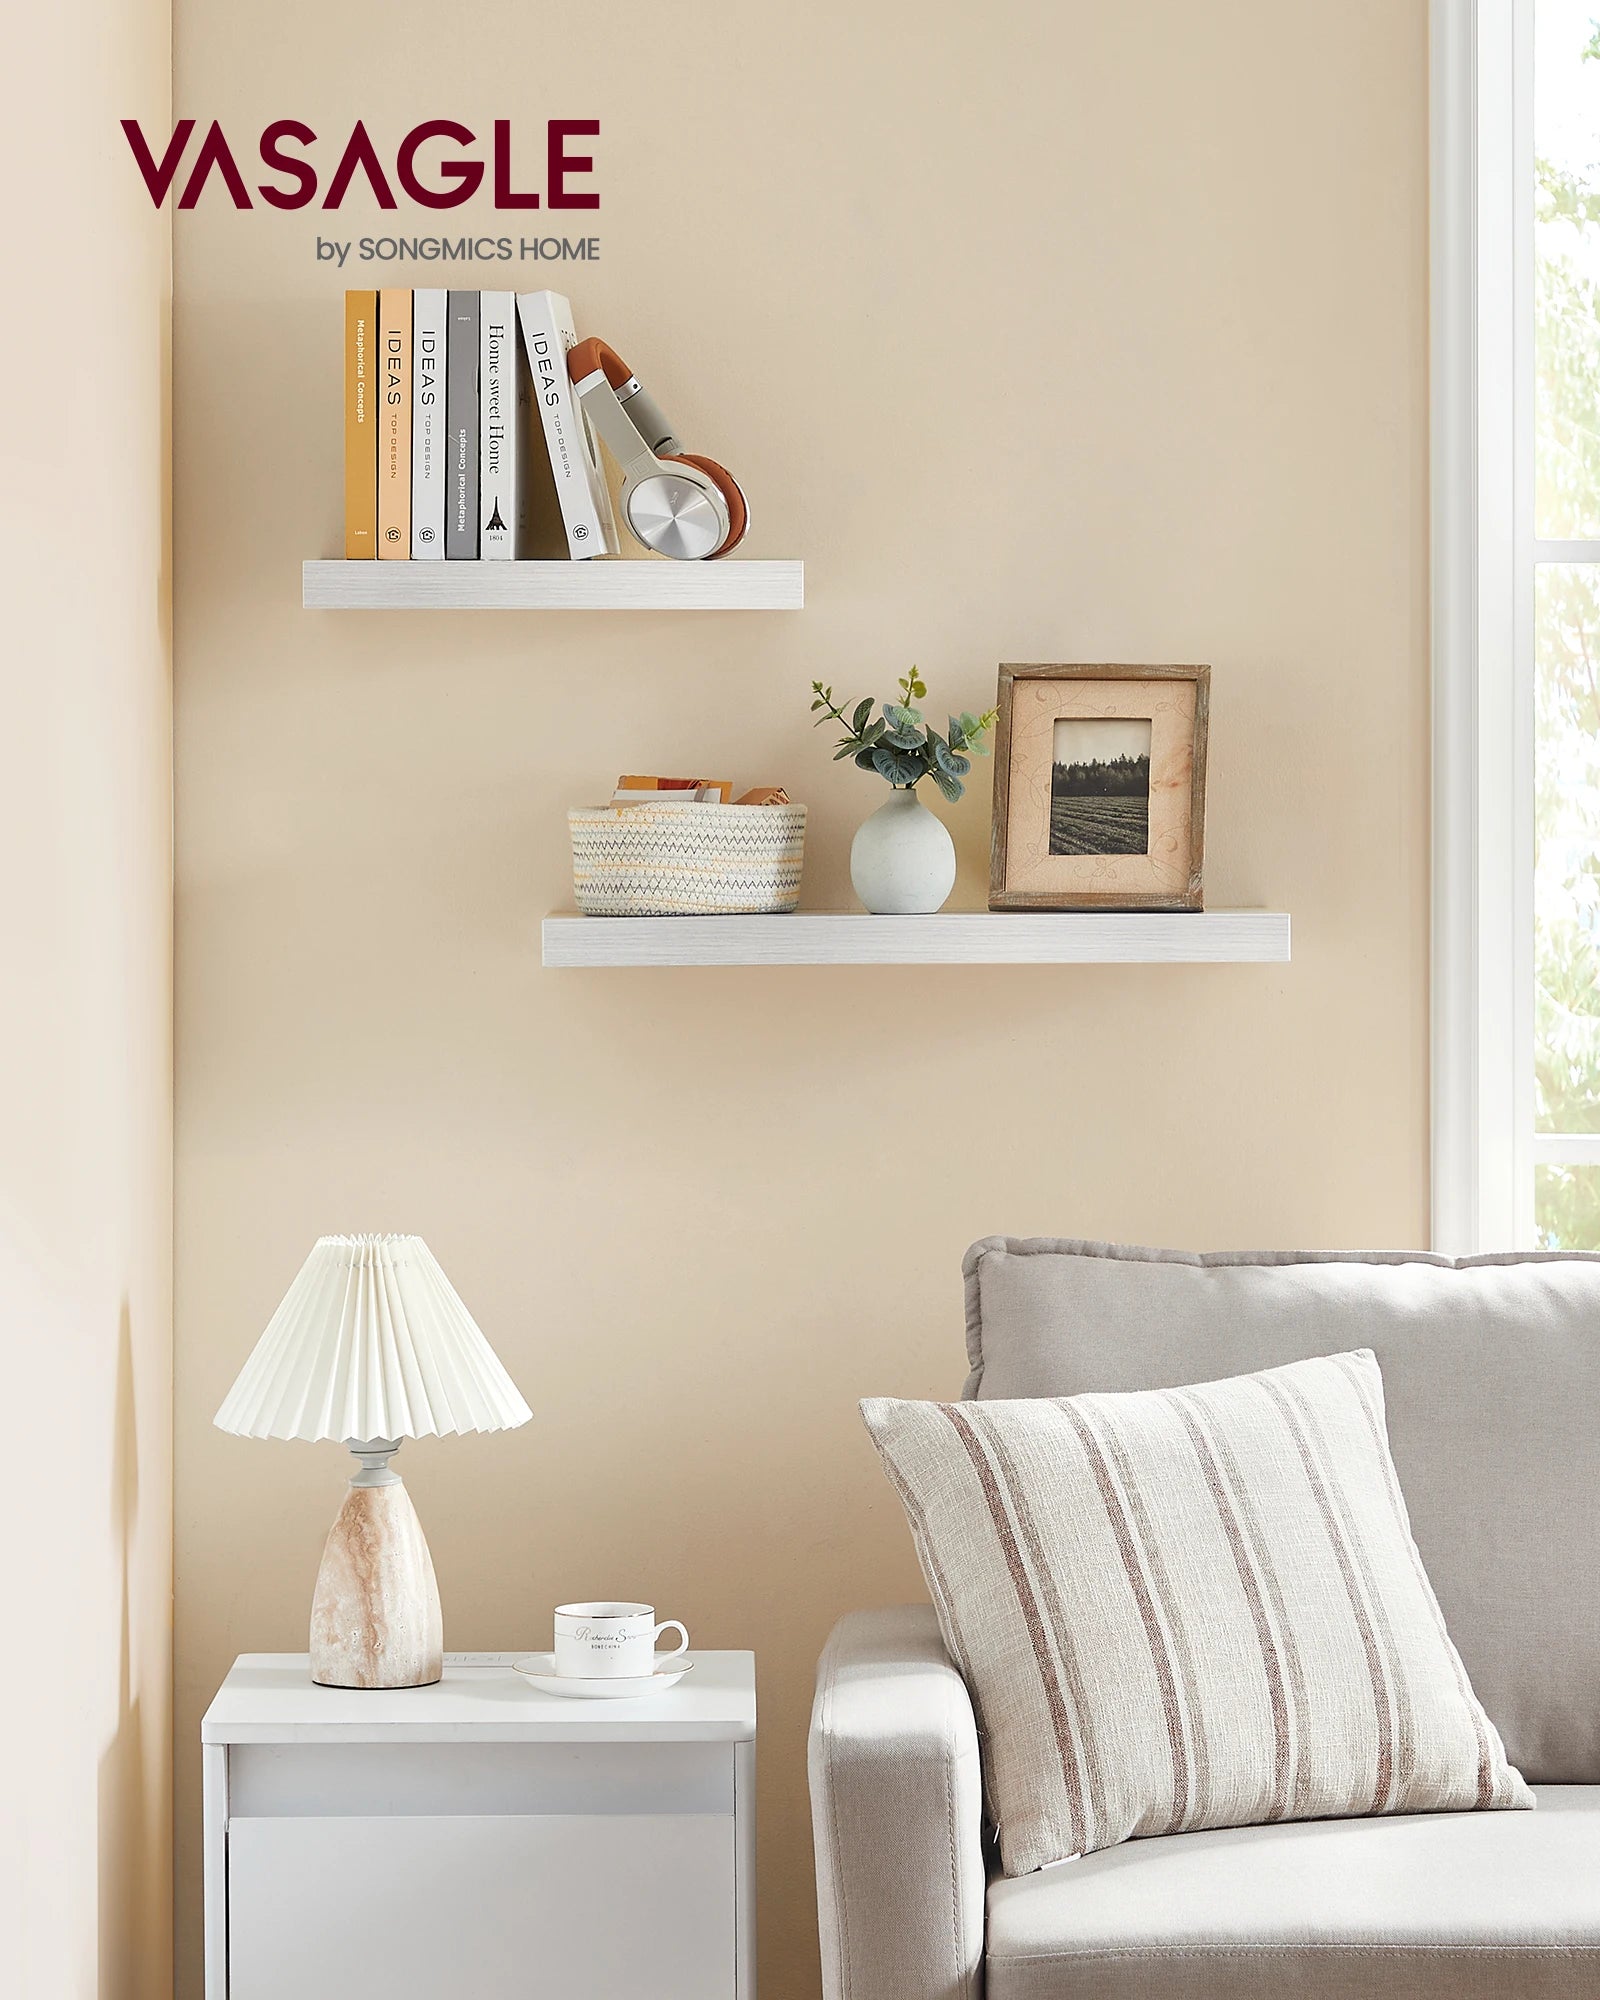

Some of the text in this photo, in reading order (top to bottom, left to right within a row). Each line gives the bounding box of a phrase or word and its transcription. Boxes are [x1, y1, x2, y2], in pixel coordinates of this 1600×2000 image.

[355, 319, 365, 423] Metaphorical Concepts
[388, 331, 401, 405] IDEAS
[422, 331, 435, 405] IDEAS
[489, 325, 504, 474] Home sweet Home
[532, 332, 572, 479] IDEAS TOP DESIGN
[457, 428, 467, 532] Metaphorical Concepts
